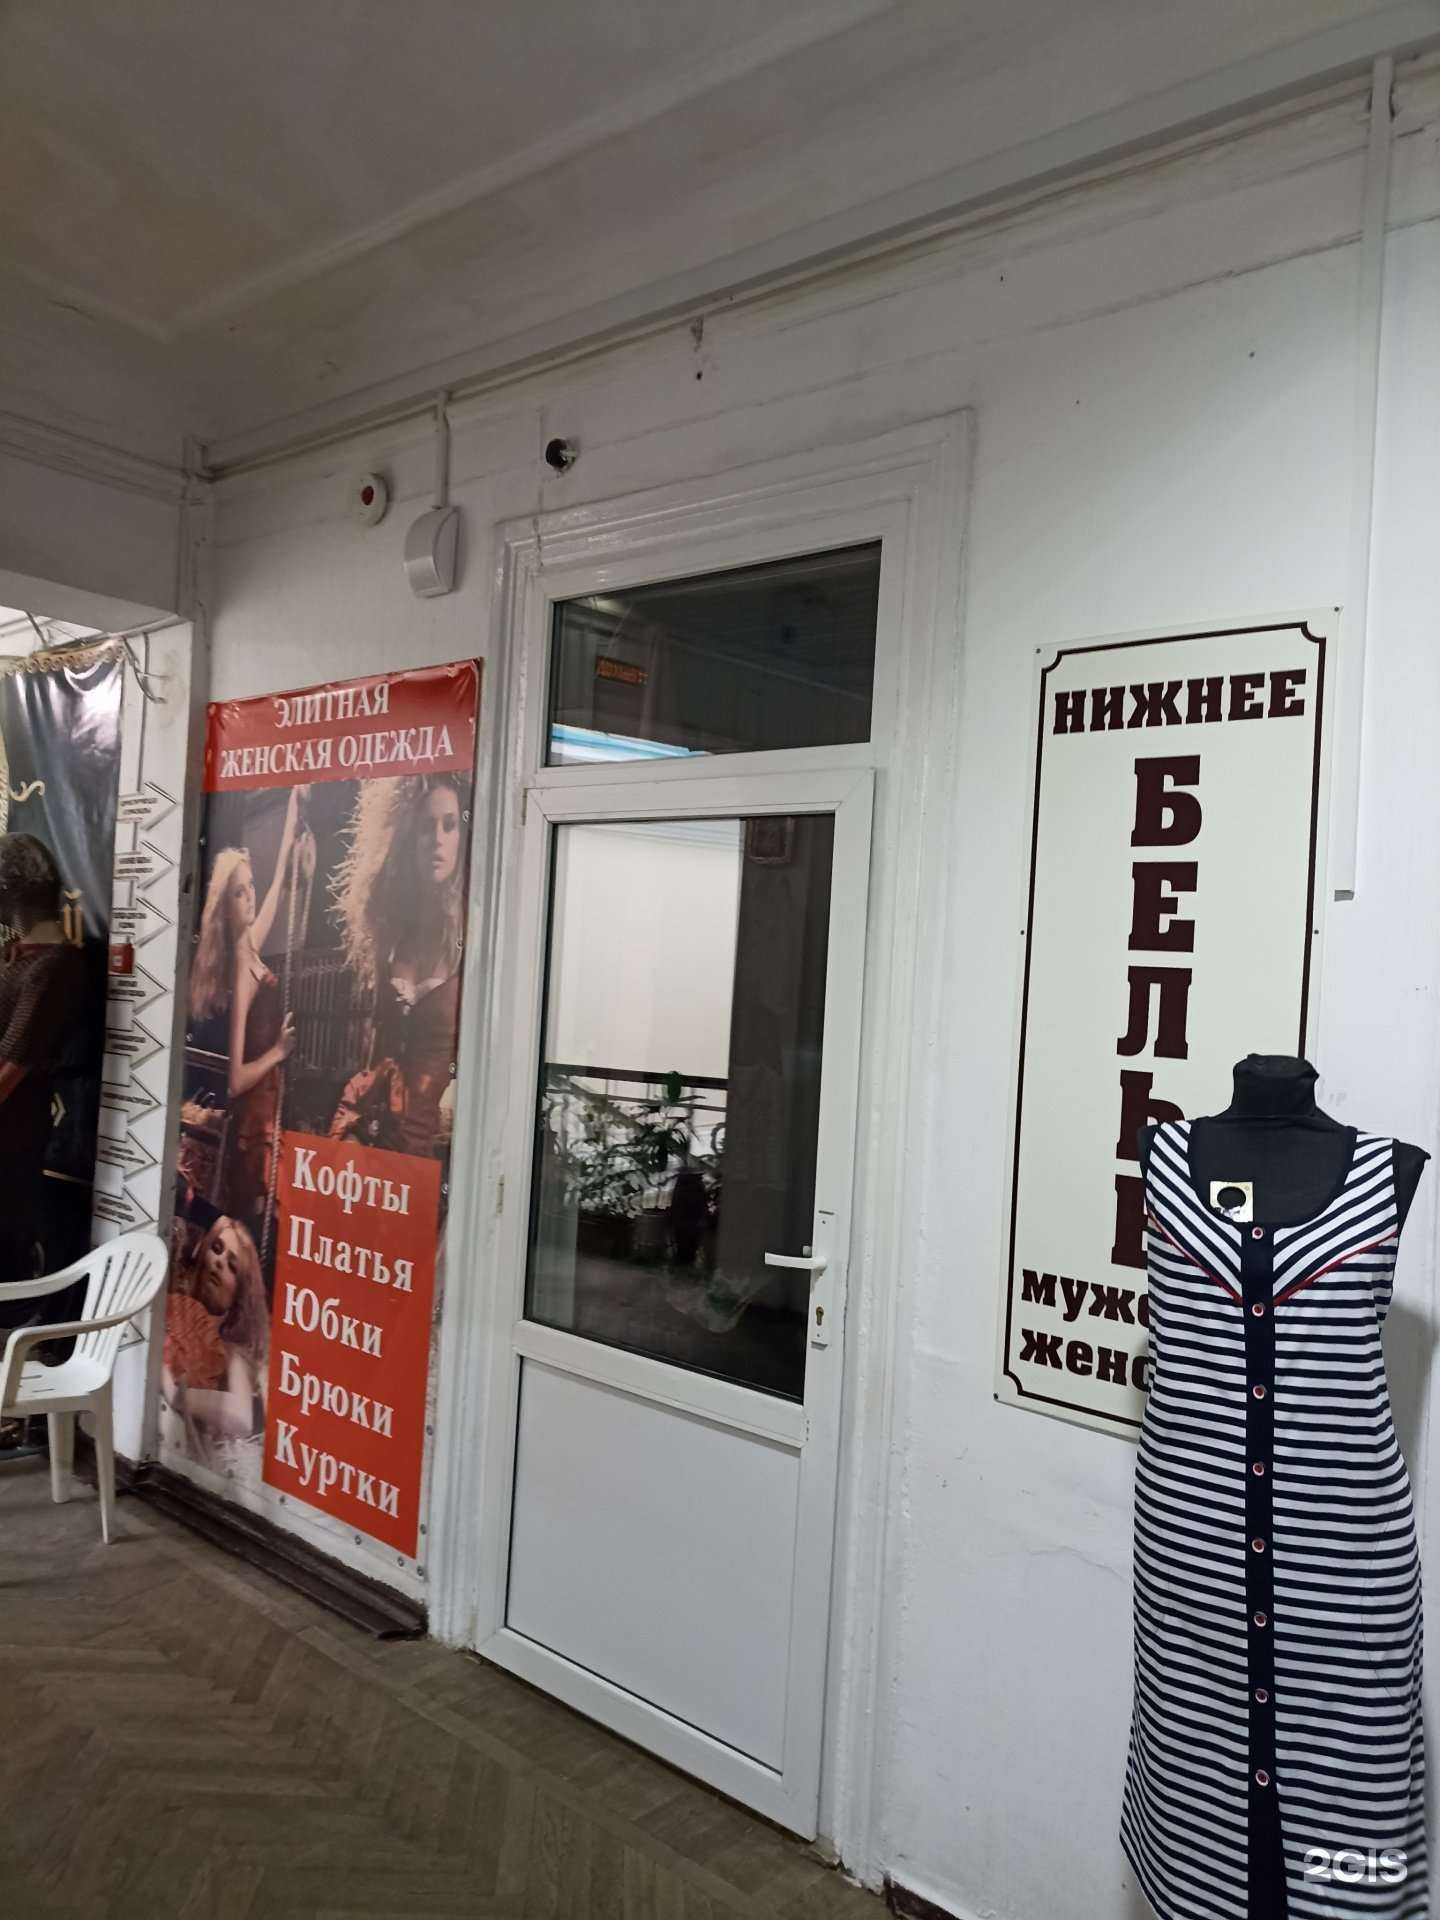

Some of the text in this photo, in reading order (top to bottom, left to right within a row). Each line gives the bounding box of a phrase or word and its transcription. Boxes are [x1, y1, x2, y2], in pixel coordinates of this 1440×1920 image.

[274, 683, 389, 728] ЭЛИТНАЯ
[1053, 668, 1307, 735] НИЖНЕЕ
[220, 724, 453, 778] ЖЕНСКАЯ ОДЕЖДА
[292, 1147, 410, 1215] Кофты
[288, 1215, 414, 1292] Платья
[283, 1282, 383, 1358] Юбки
[278, 1350, 394, 1438] Брюки
[274, 1419, 400, 1518] Куртки
